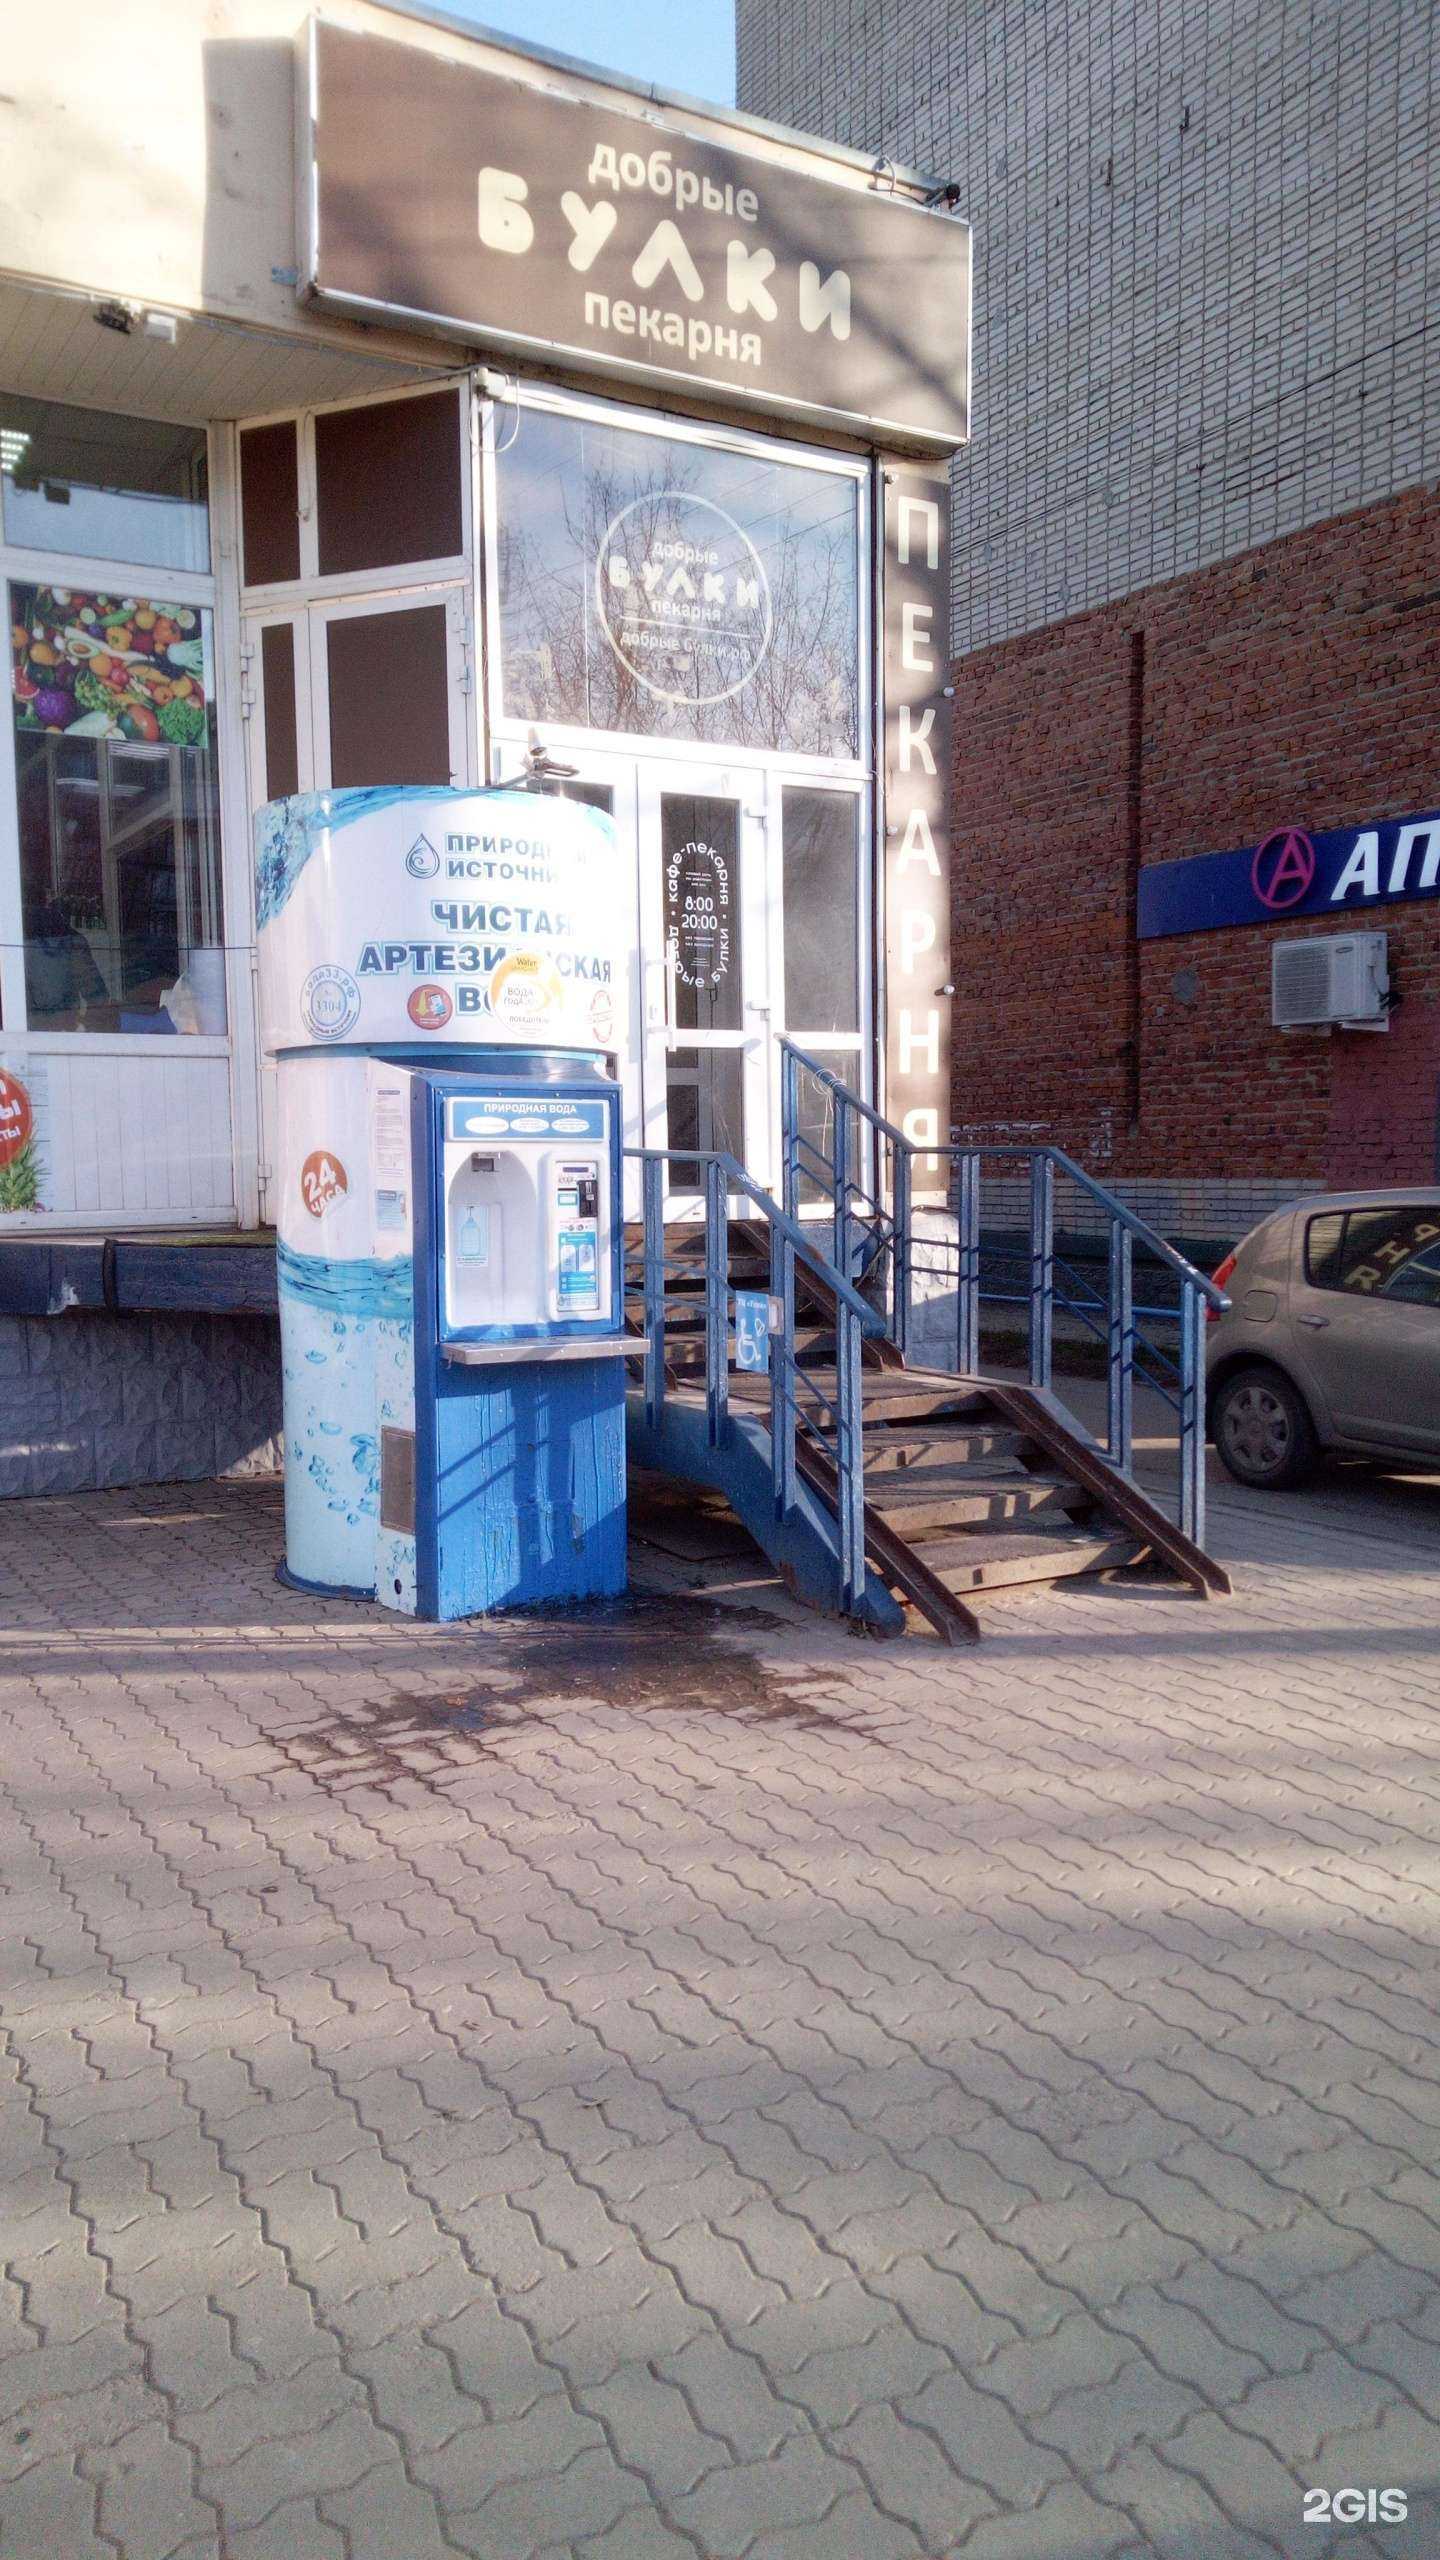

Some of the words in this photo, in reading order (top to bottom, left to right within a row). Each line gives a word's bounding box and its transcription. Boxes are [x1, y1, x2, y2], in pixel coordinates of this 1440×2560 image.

[588, 143, 759, 222] добрые
[478, 166, 852, 341] БУЛКИ
[584, 291, 762, 366] пекарня
[651, 541, 719, 565] добрые
[609, 554, 760, 609] БУЛКИ
[651, 600, 721, 622] пекарня
[447, 833, 587, 865] ПРИРОД
[897, 496, 942, 1172] ПЕКАРНЯ
[447, 859, 560, 884] ИСТОЧНИ
[666, 842, 729, 905] кафе-пекарня
[1331, 819, 1440, 901] АП
[432, 902, 573, 935] ЧИСТАЯ
[681, 913, 718, 931] 20:00
[685, 895, 714, 912] 8:00
[358, 945, 612, 984] АРТЕЗИСКАЯ
[710, 928, 730, 983] булки
[484, 1103, 547, 1114] ПРИРОДНАЯ
[549, 1104, 577, 1114] ВОДА
[304, 1158, 337, 1203] 24
